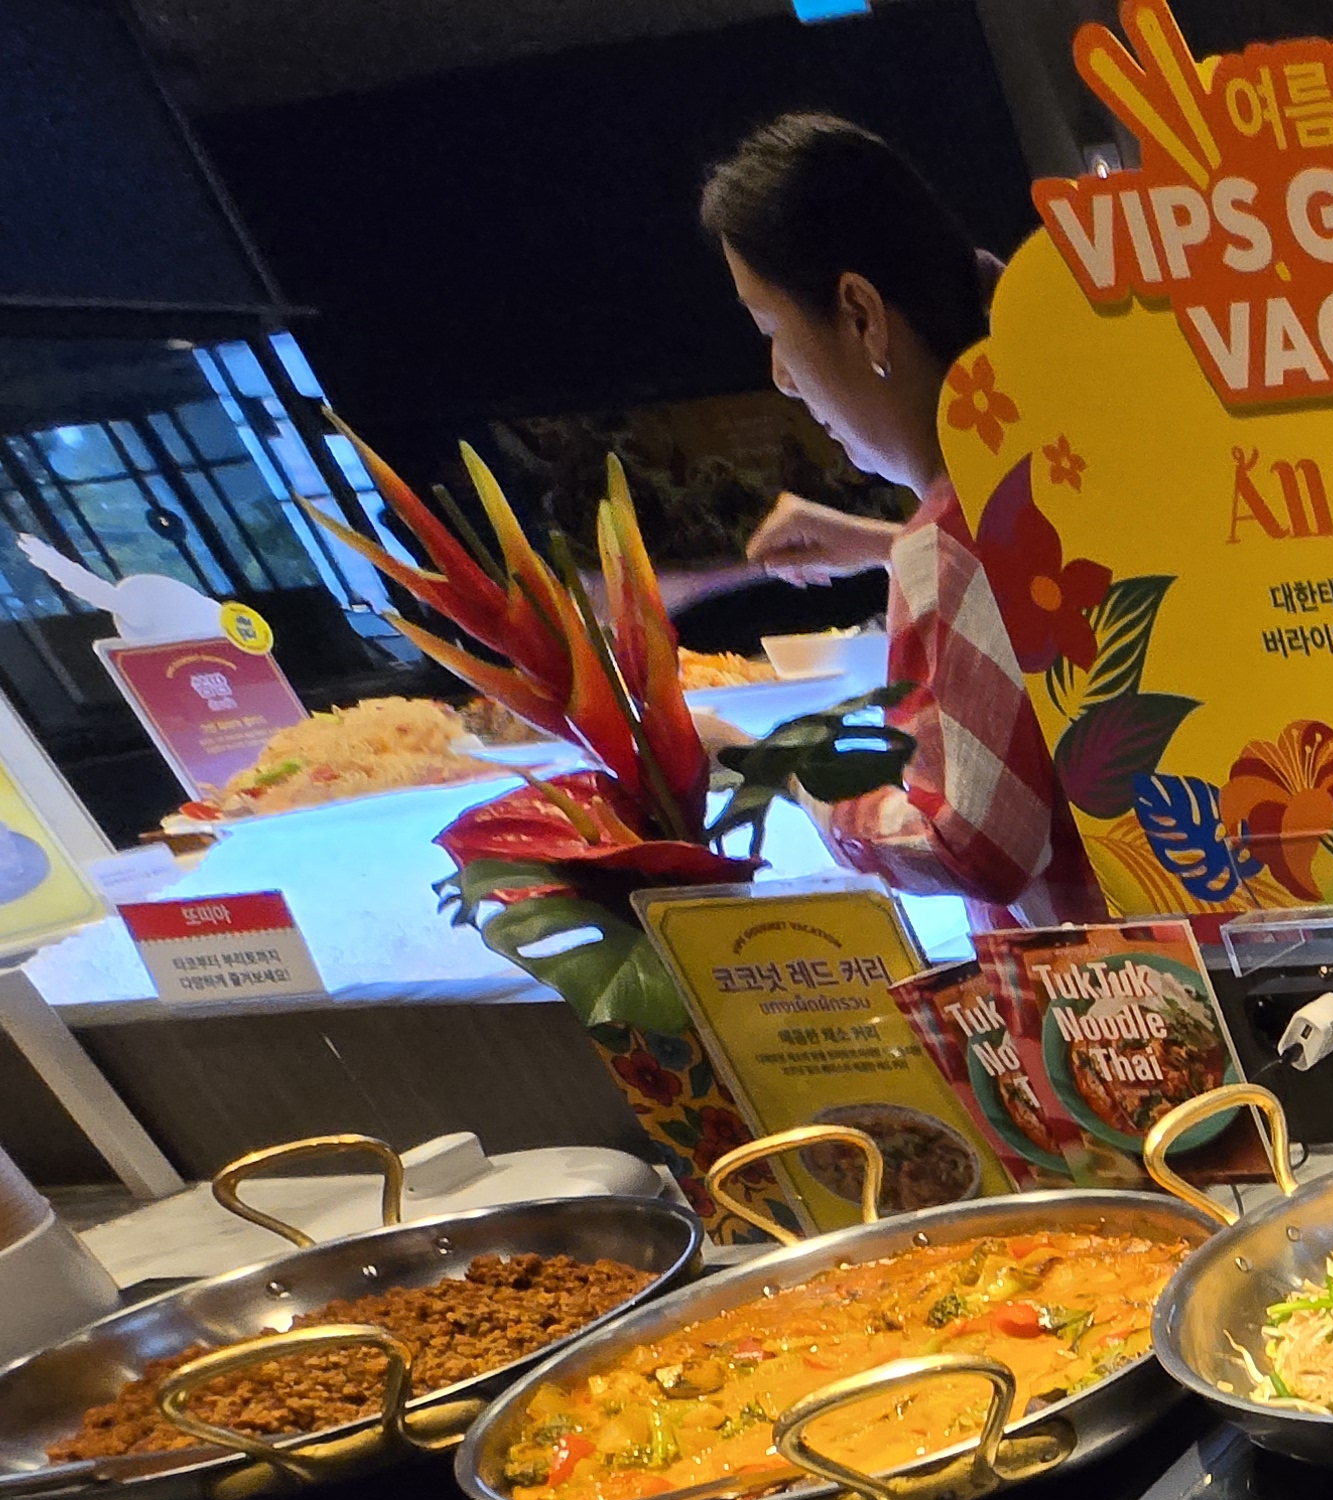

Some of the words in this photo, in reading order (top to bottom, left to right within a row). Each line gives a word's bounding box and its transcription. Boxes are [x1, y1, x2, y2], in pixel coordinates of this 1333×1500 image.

[1048, 176, 1270, 290] VIPS
[712, 961, 788, 993] 코코넛
[786, 957, 840, 989] 레드
[839, 955, 893, 987] 커리
[1051, 1003, 1168, 1042] Noodle
[1089, 1047, 1164, 1082] Thai
